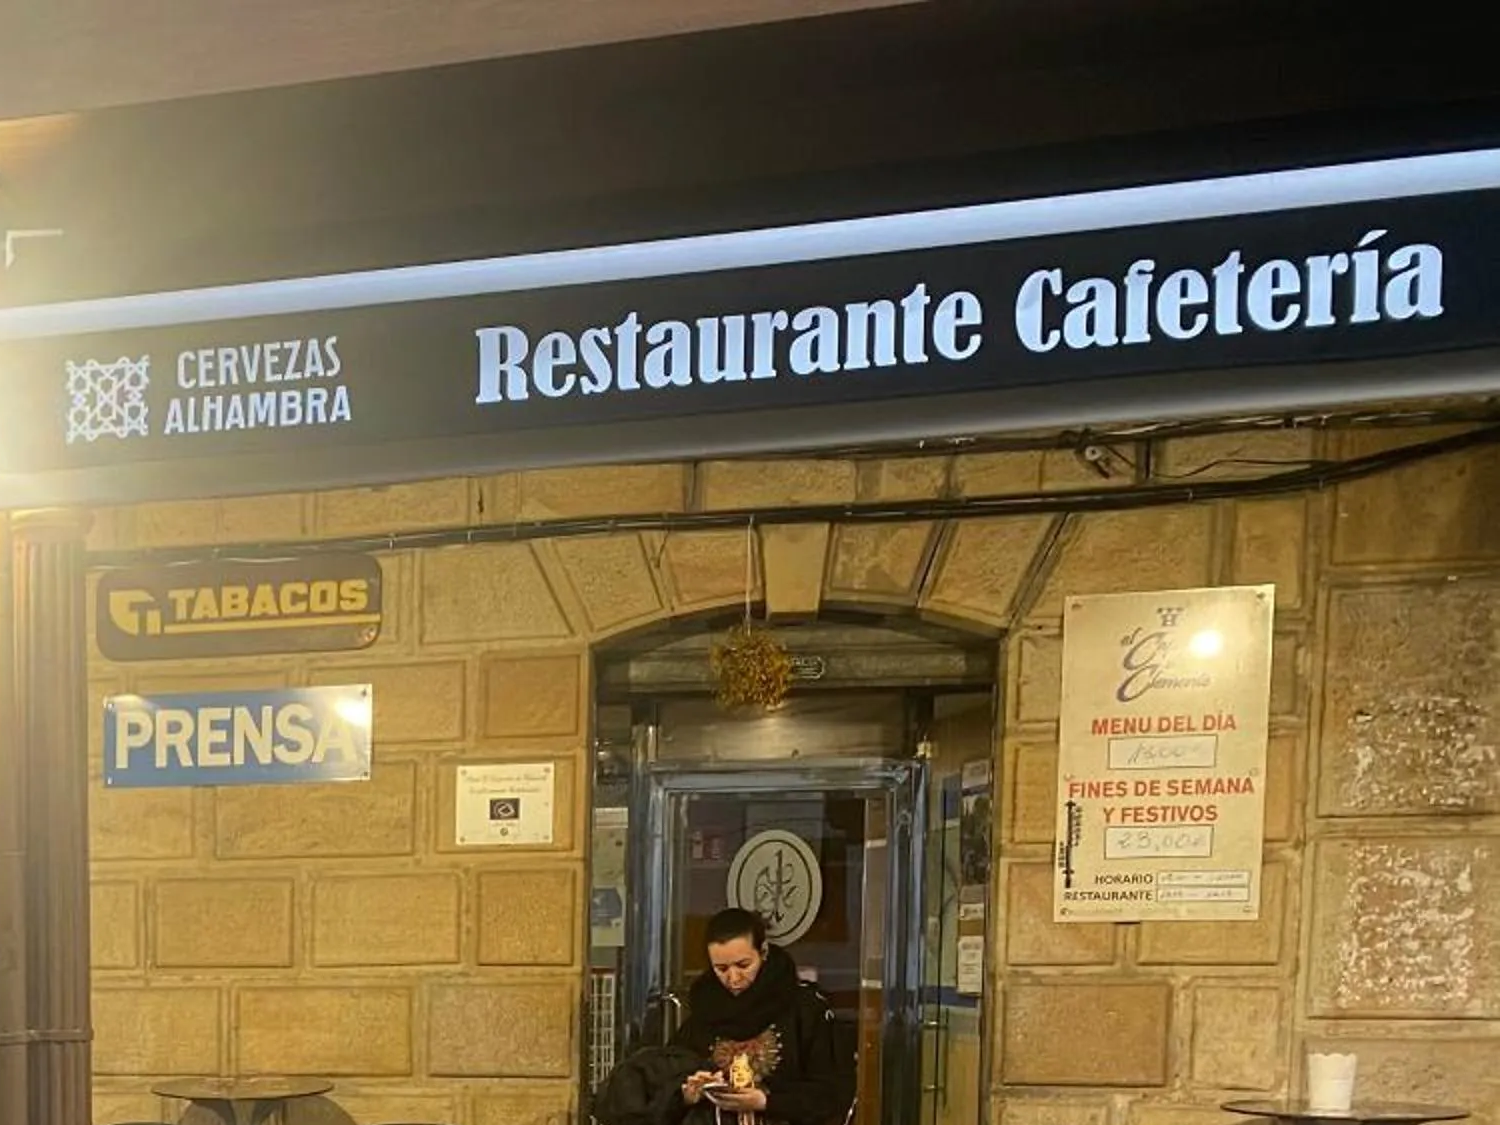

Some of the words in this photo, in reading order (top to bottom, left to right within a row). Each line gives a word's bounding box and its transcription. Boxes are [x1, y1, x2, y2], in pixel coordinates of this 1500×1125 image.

[474, 282, 983, 404] Restaurante
[1014, 228, 1445, 354] Cafetería
[176, 335, 342, 390] CERVEZAS
[163, 385, 352, 435] ALHAMBRA
[167, 580, 370, 618] TABACOS
[114, 703, 357, 769] PRENSA
[1091, 717, 1151, 735] MENU
[1158, 715, 1196, 733] DEL
[1068, 781, 1128, 799] FINES
[1134, 780, 1161, 797] DE
[1167, 776, 1255, 796] SEMANA
[1102, 807, 1116, 824] Y
[1121, 804, 1218, 824] FESTIVOS
[1094, 873, 1154, 886] HORARIO
[1064, 889, 1154, 902] RESTAURANTE
